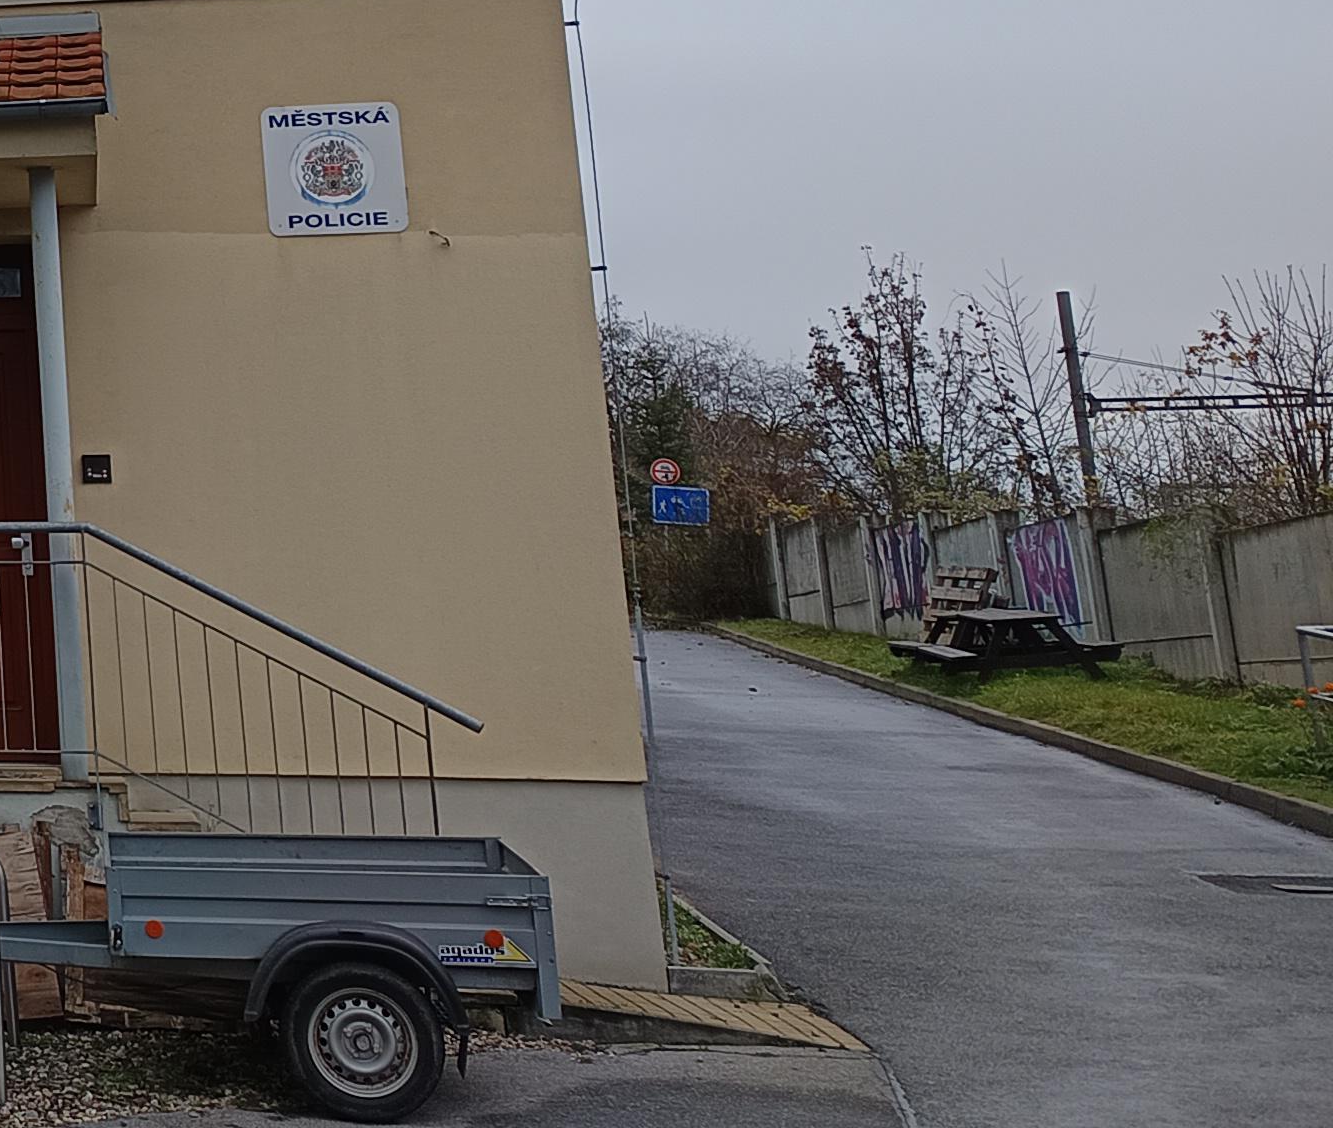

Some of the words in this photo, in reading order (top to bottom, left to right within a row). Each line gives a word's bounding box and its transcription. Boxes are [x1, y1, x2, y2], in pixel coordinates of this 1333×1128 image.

[268, 106, 390, 128] MĚSTSKÁ
[288, 211, 389, 229] POLICIE
[440, 943, 505, 960] agados
